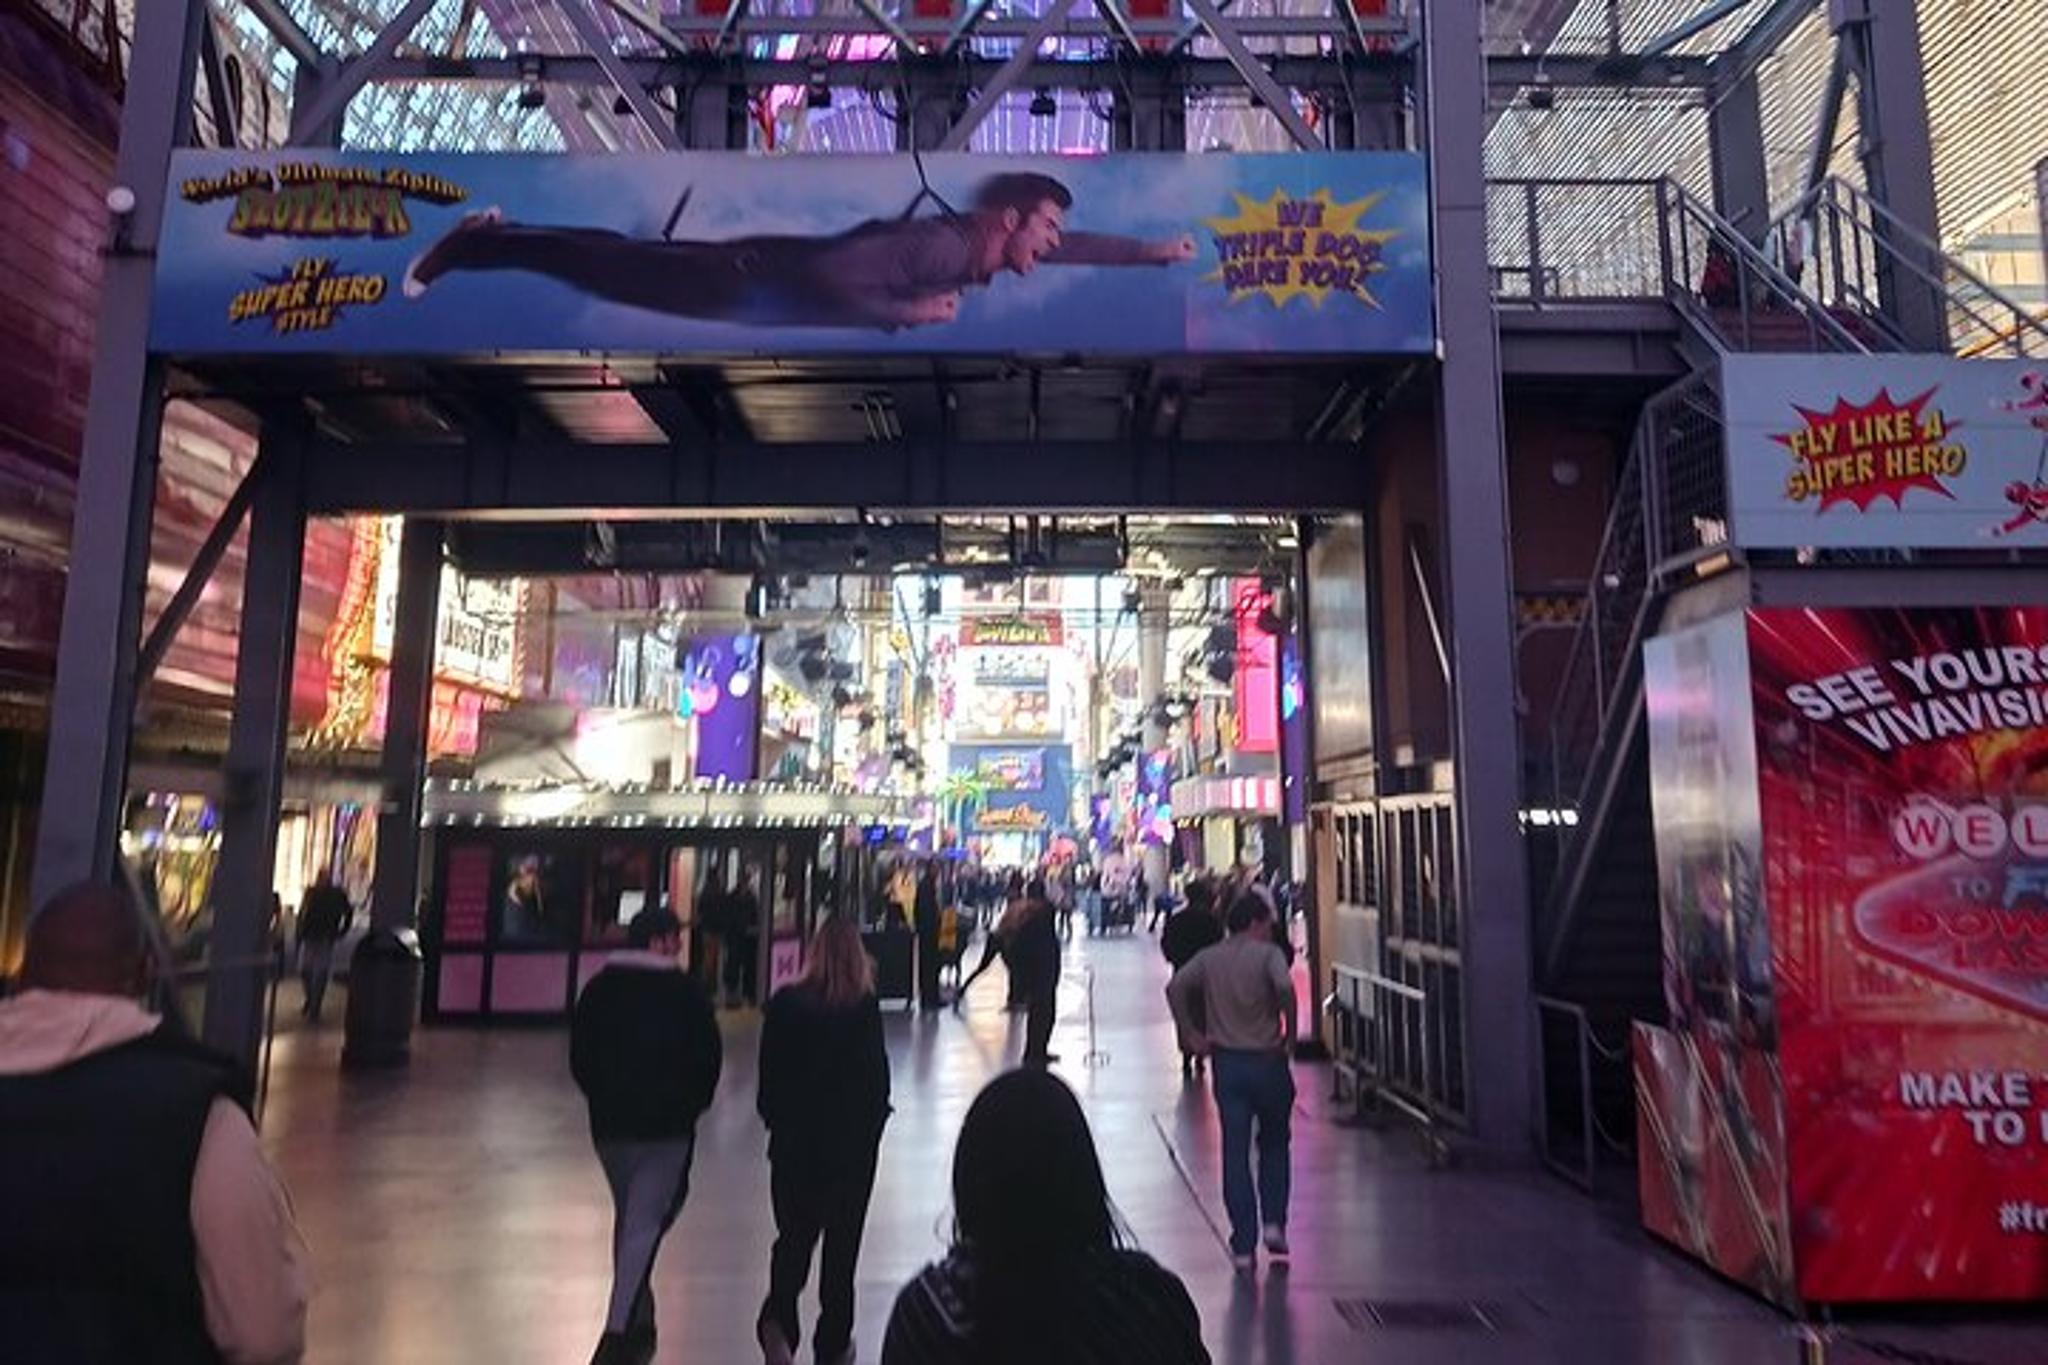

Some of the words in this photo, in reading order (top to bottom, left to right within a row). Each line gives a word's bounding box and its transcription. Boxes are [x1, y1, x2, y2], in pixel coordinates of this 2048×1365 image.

[1276, 200, 1325, 227] WE
[1214, 231, 1304, 262] TRIPLE
[1314, 232, 1382, 265] DOG
[1223, 258, 1289, 292] DARE
[228, 280, 310, 322] SUPER
[316, 273, 386, 304] HERO
[274, 306, 333, 333] STYLE
[1790, 424, 1838, 461] FLY
[1849, 410, 1913, 448] LIKE
[1922, 409, 1946, 440] A
[1787, 452, 1876, 502] SUPER
[1885, 443, 1967, 477] HERO
[1785, 664, 1897, 721] SEE
[1844, 686, 2048, 751] VIVAVISI
[1900, 1070, 2031, 1107] MAKE
[1963, 1109, 2025, 1145] TO
